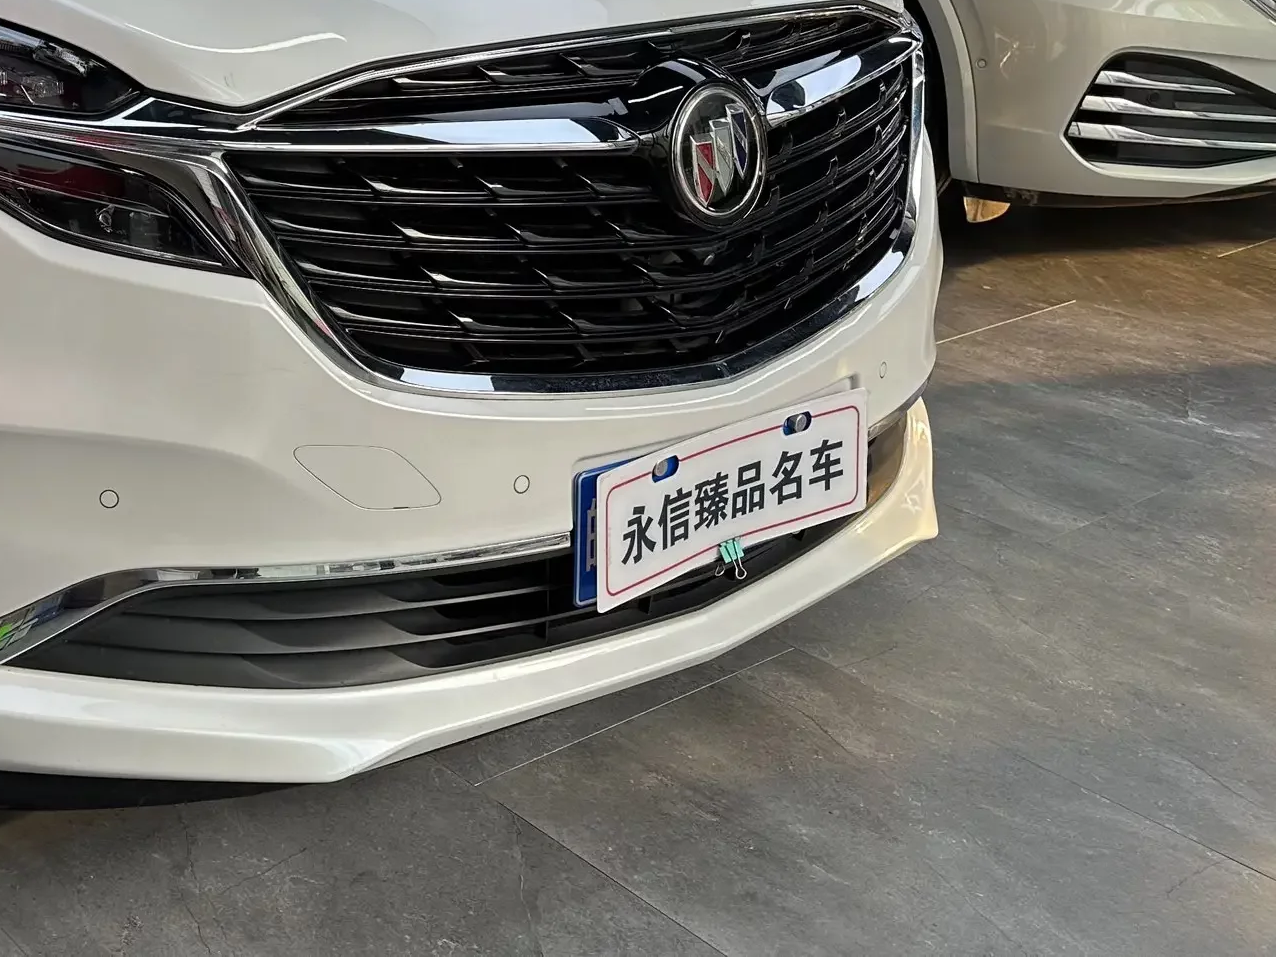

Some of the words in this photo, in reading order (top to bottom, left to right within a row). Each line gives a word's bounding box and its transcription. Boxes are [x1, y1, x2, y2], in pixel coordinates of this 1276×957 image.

[621, 439, 844, 565] 永信臻品名车
